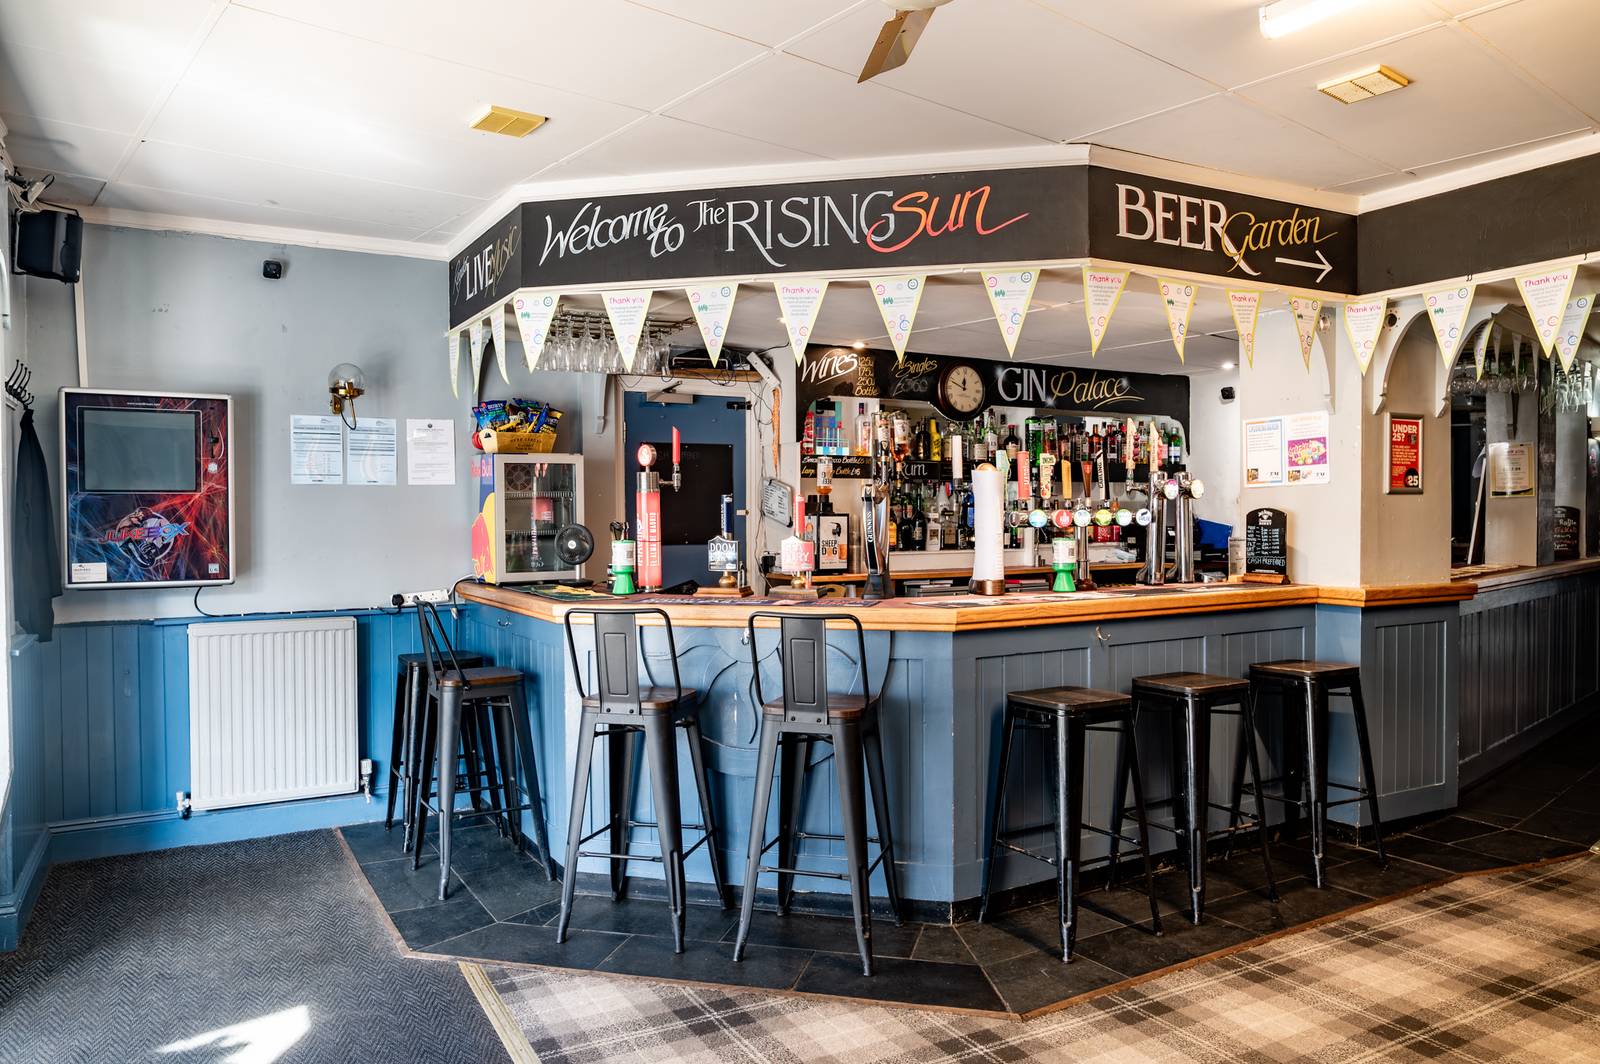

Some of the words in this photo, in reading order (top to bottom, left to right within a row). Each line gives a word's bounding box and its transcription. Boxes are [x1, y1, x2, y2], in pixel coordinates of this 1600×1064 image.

[538, 202, 668, 267] Welcome
[648, 216, 685, 259] to
[687, 198, 726, 232] The
[725, 190, 895, 267] RISING
[1115, 183, 1261, 276] BEER
[1221, 208, 1338, 273] Garden
[466, 243, 493, 301] LIVE
[801, 349, 858, 384] Wines
[998, 366, 1047, 402] GIN
[1050, 370, 1131, 404] Palace
[1392, 423, 1418, 434] UNDER
[1392, 432, 1406, 442] 25?
[1407, 475, 1419, 486] 25
[98, 522, 192, 544] JUKEBOX
[710, 542, 736, 552] DOOM
